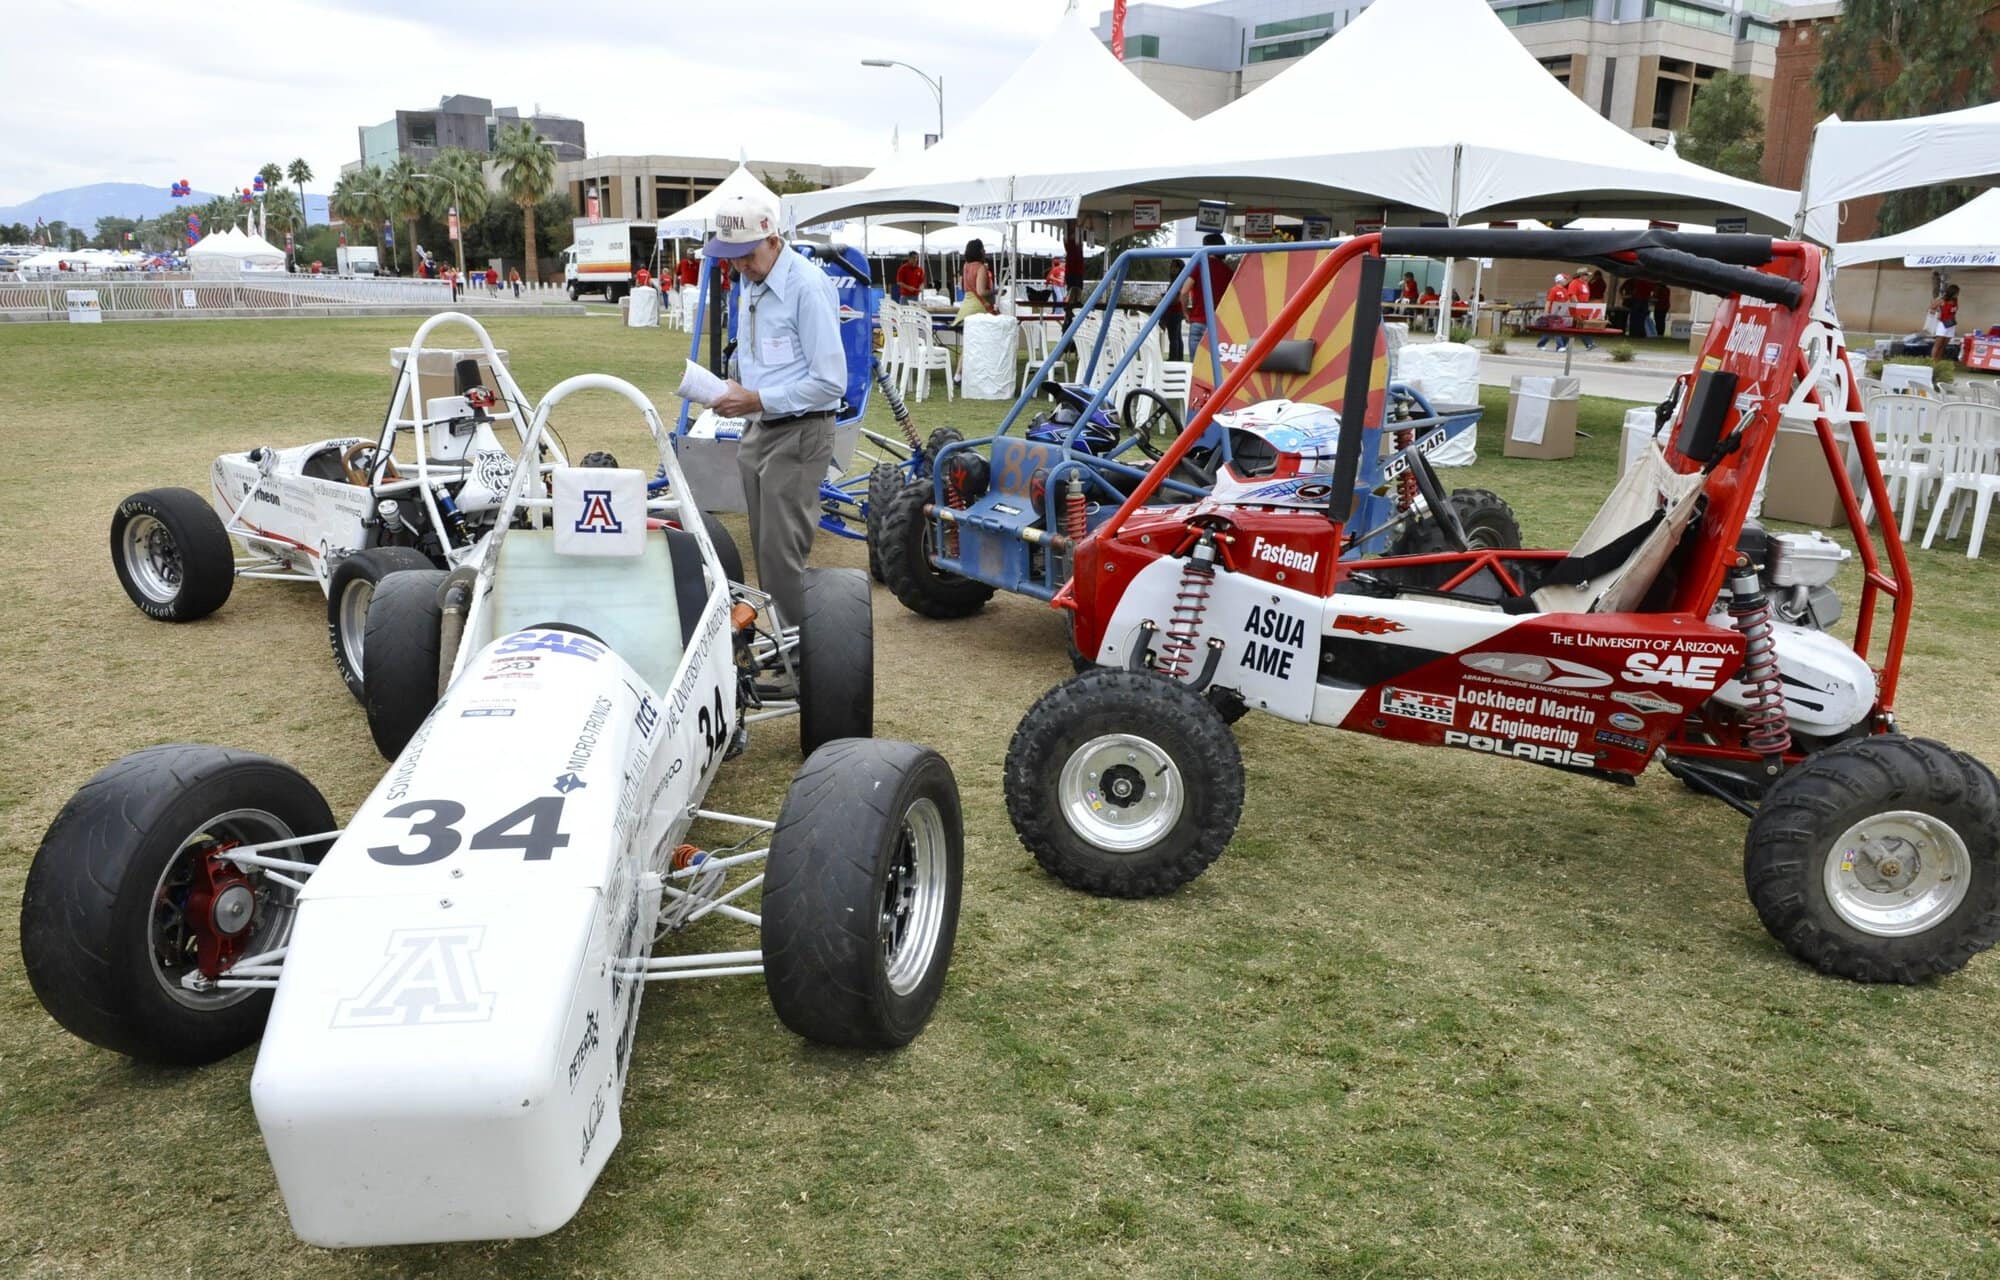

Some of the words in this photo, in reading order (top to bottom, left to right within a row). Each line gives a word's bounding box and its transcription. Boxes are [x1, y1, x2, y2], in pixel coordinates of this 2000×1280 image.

[966, 205, 1002, 222] COLLEGE
[1006, 203, 1017, 219] OF
[1022, 198, 1074, 218] PHARMACY
[1917, 255, 1966, 265] ARIZONA
[1217, 342, 1248, 364] SAE
[1724, 313, 1767, 361] Raytheon
[575, 490, 622, 533] A
[1252, 536, 1319, 573] Fastenal
[1244, 604, 1305, 648] ASUA
[1550, 632, 1574, 645] THE
[1577, 633, 1651, 650] UNIVERSITY
[1653, 638, 1671, 650] OF
[494, 633, 606, 662] SAE
[1240, 640, 1294, 680] AME
[1462, 674, 1491, 683] ABRAMS
[1492, 678, 1529, 689] AIRBORNE
[1620, 652, 1725, 690] SAE
[1382, 705, 1451, 723] ENDS
[1399, 702, 1453, 716] ROD
[1458, 685, 1537, 715] Lockheed
[1540, 698, 1596, 725] Martin
[566, 694, 613, 773] MICRO-TRONICS
[1445, 730, 1596, 768] POLARIS
[1469, 711, 1490, 731] AZ
[1491, 714, 1579, 749] Engineering
[367, 796, 571, 866] 34
[328, 925, 497, 1030] A
